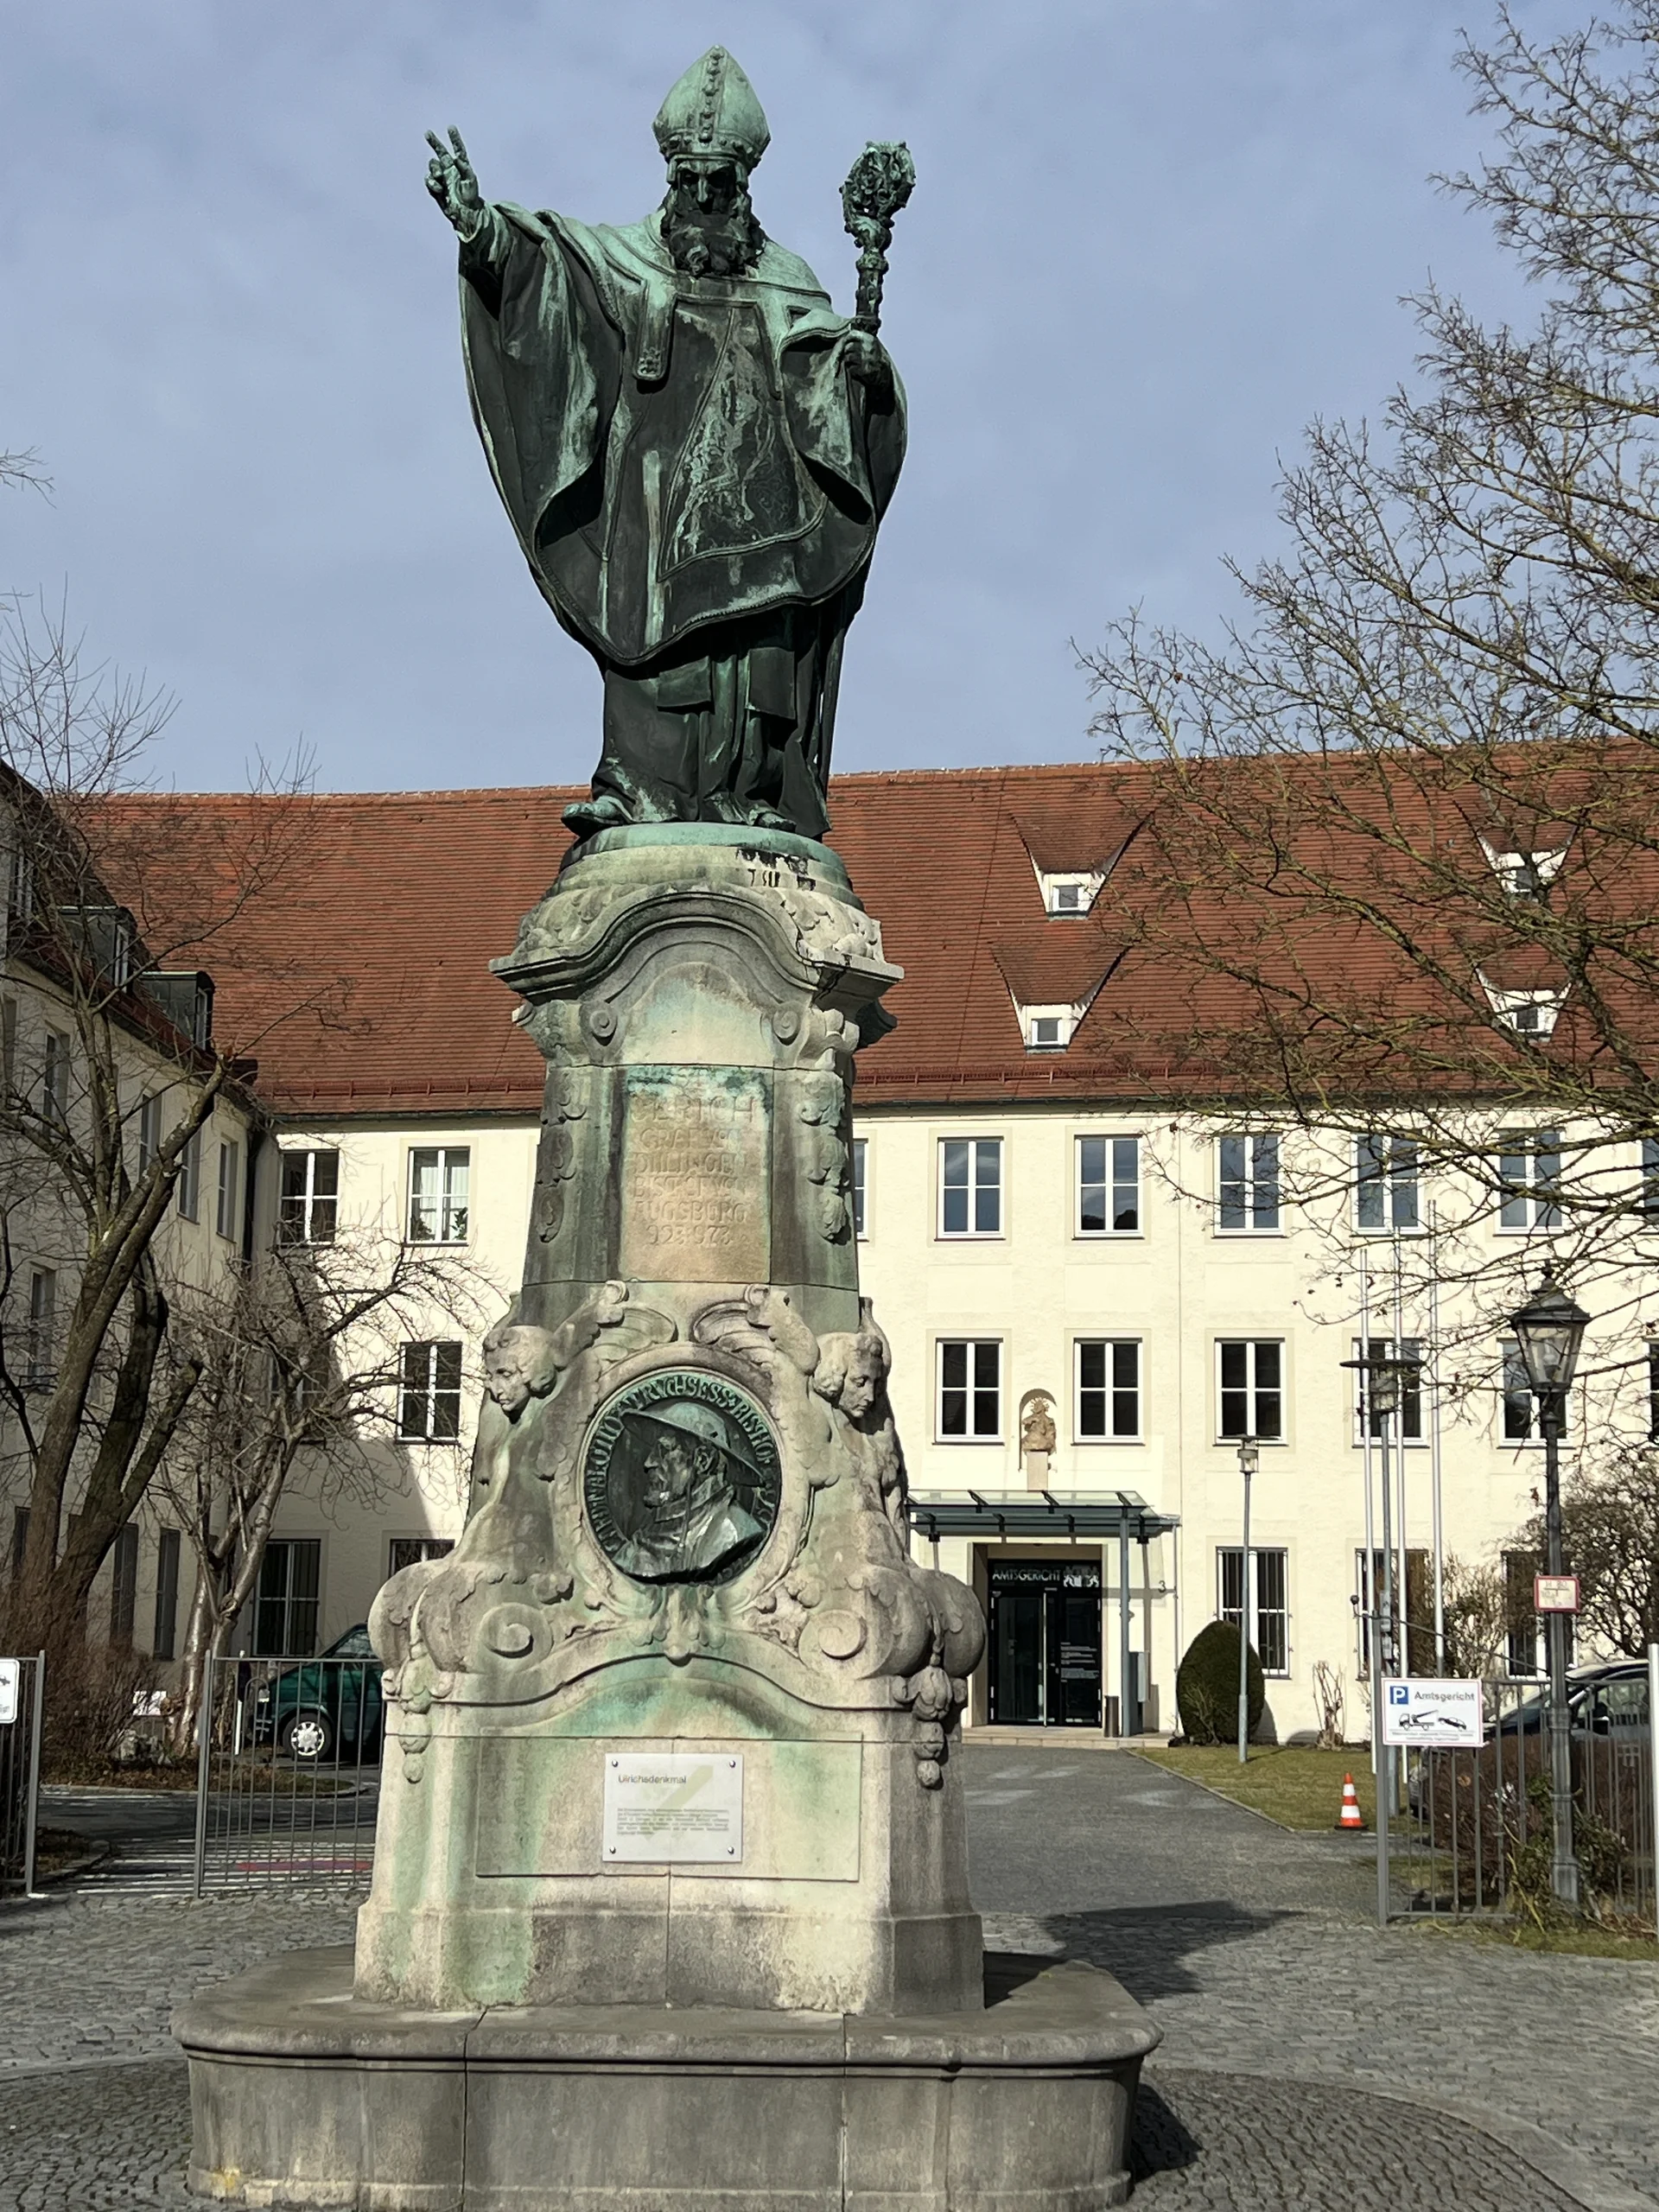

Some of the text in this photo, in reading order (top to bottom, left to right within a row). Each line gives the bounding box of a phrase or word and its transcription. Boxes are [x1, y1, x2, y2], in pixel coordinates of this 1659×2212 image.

[992, 1568, 1062, 1581] AMTSGERICHT
[1157, 1580, 1166, 1593] 3
[1393, 1687, 1476, 1704] P Amtsgericht
[618, 1774, 687, 1784] Ulrichsdenkmal
